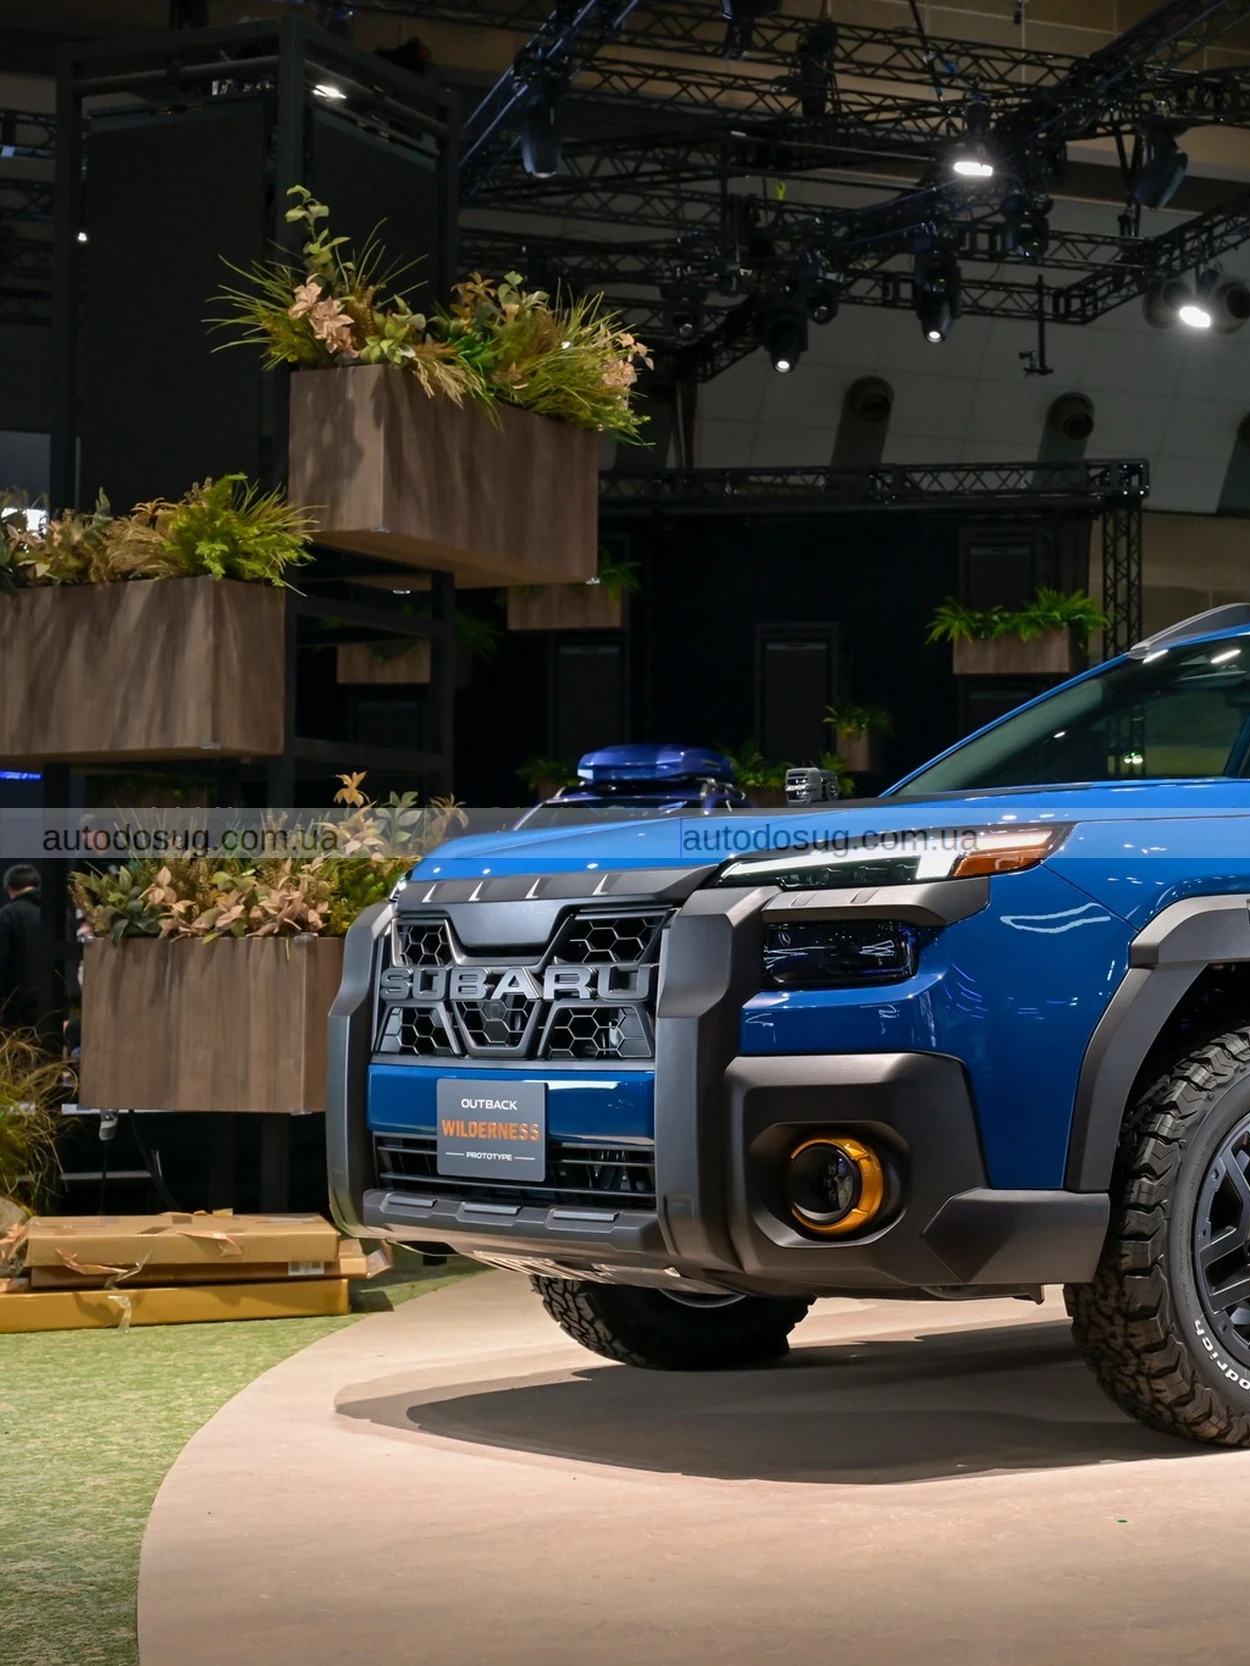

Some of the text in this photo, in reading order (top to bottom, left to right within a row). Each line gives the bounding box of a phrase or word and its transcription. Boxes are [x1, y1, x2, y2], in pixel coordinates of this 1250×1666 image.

[380, 966, 650, 1000] SUBARU
[461, 1098, 518, 1111] OUTBACK
[441, 1119, 540, 1142] WILDERNESS
[466, 1151, 513, 1161] PROTOTYPE
